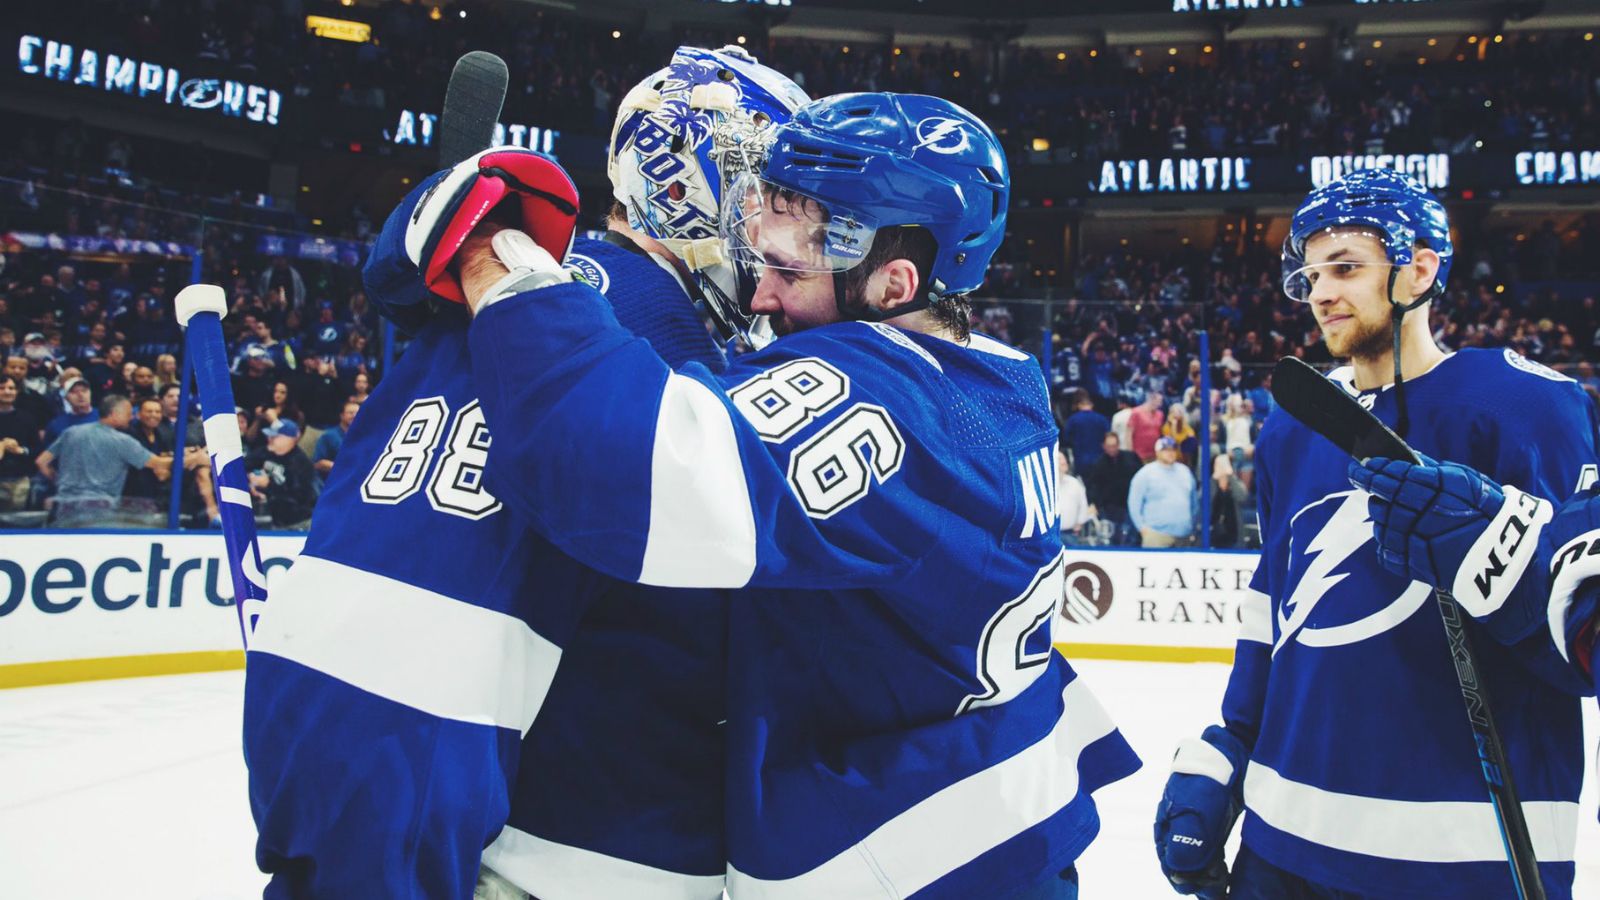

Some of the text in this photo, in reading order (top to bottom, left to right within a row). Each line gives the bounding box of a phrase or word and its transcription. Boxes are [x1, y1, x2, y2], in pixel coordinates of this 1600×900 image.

[1098, 157, 1251, 192] ATLANTIC
[360, 395, 503, 521] 88
[725, 357, 906, 520] 86
[1473, 493, 1541, 601] CCM
[1137, 600, 1243, 624] RAN
[1434, 586, 1488, 727] NEXU
